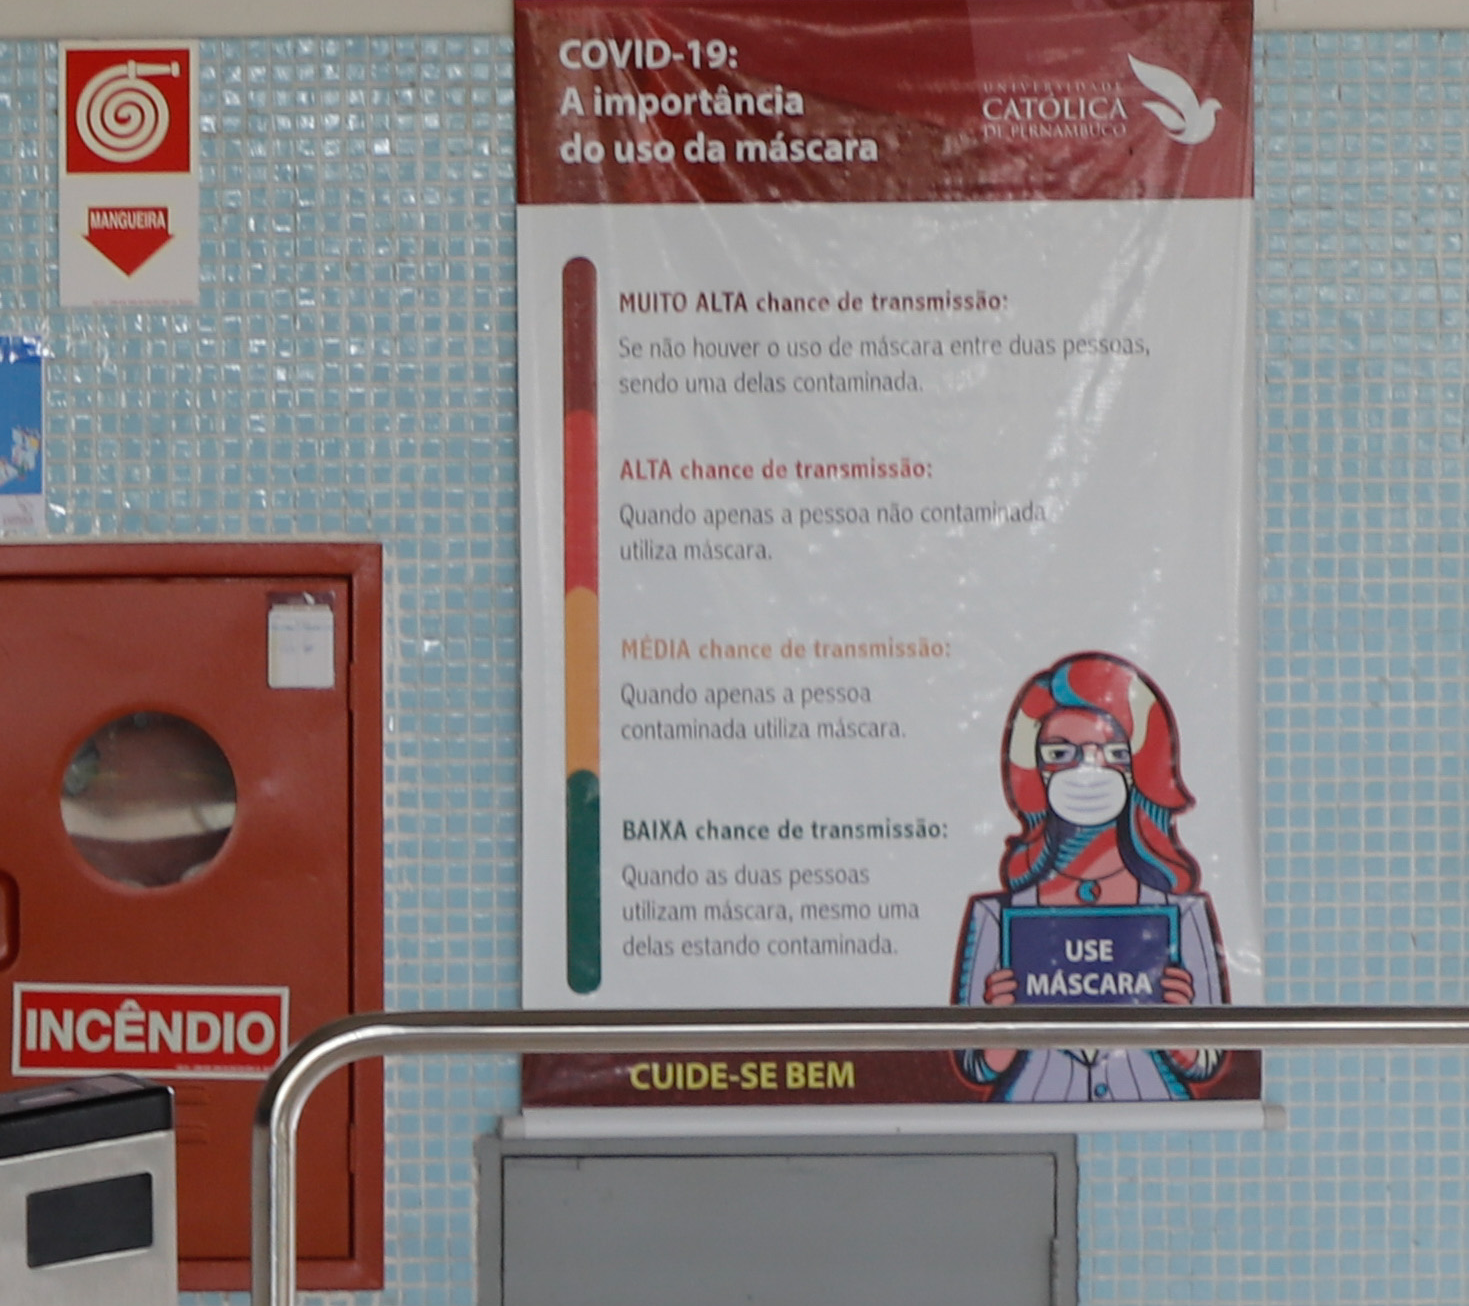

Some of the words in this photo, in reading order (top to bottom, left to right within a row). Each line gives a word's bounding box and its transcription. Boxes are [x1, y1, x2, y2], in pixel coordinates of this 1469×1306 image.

[559, 38, 738, 70] COVID-19:
[560, 86, 585, 117] A
[594, 82, 804, 125] importância
[982, 91, 1128, 121] CATÓLICA
[1011, 123, 1127, 138] PERNAMBUCO
[559, 131, 605, 164] do
[614, 138, 676, 164] uso
[684, 130, 726, 163] da
[736, 129, 878, 163] máscara
[89, 209, 168, 231] MANGUEIRA
[619, 292, 688, 314] MUITO
[695, 291, 748, 313] ALTA
[756, 290, 830, 313] chance
[837, 290, 863, 312] de
[871, 289, 1008, 312] transmissão:
[619, 339, 643, 358] Se
[649, 337, 686, 359] não
[693, 336, 761, 358] houver
[767, 341, 781, 358] o
[787, 341, 823, 358] uso
[828, 335, 853, 358] de
[860, 335, 944, 357] máscara
[949, 335, 1002, 356] entre
[1008, 333, 1057, 356] duas
[1062, 337, 1151, 362] pessoas,
[619, 372, 679, 394] sendo
[685, 377, 727, 394] uma
[733, 371, 787, 394] delas
[793, 369, 923, 393] contaminada.
[620, 458, 673, 480] ALTA
[680, 458, 754, 480] chance
[761, 458, 788, 480] de
[794, 456, 932, 480] transmissão:
[619, 503, 697, 529] Quando
[703, 508, 775, 531] apenas
[781, 508, 793, 525] a
[799, 507, 870, 529] pessoa
[876, 502, 914, 524] não
[920, 499, 1046, 523] contaminada
[620, 539, 678, 561] utiliza
[683, 541, 773, 561] máscara.
[621, 634, 691, 660] MÉDIA
[698, 637, 772, 660] chance
[780, 638, 806, 659] de
[813, 636, 951, 659] transmissão:
[620, 682, 698, 709] Quando
[704, 687, 776, 710] apenas
[782, 687, 794, 704] a
[801, 686, 872, 710] pessoa
[621, 717, 747, 740] contaminada
[753, 717, 811, 740] utiliza
[817, 718, 906, 739] máscara.
[623, 819, 688, 841] BAIXA
[695, 819, 770, 841] chance
[777, 818, 804, 840] de
[810, 817, 948, 840] transmissão:
[622, 864, 699, 889] Quando
[705, 869, 728, 886] as
[734, 863, 783, 886] duas
[789, 868, 870, 891] pessoas
[622, 900, 697, 922] utilizam
[704, 900, 794, 923] máscara,
[800, 903, 871, 920] mesmo
[877, 902, 920, 920] uma
[623, 935, 675, 957] delas
[681, 933, 761, 957] estando
[766, 932, 898, 956] contaminada.
[1065, 939, 1114, 962] USE
[1027, 970, 1152, 997] MÁSCARA
[25, 999, 276, 1056] INCÊNDIO
[629, 1062, 777, 1089] CUIDE-SE
[786, 1061, 855, 1088] BEM
